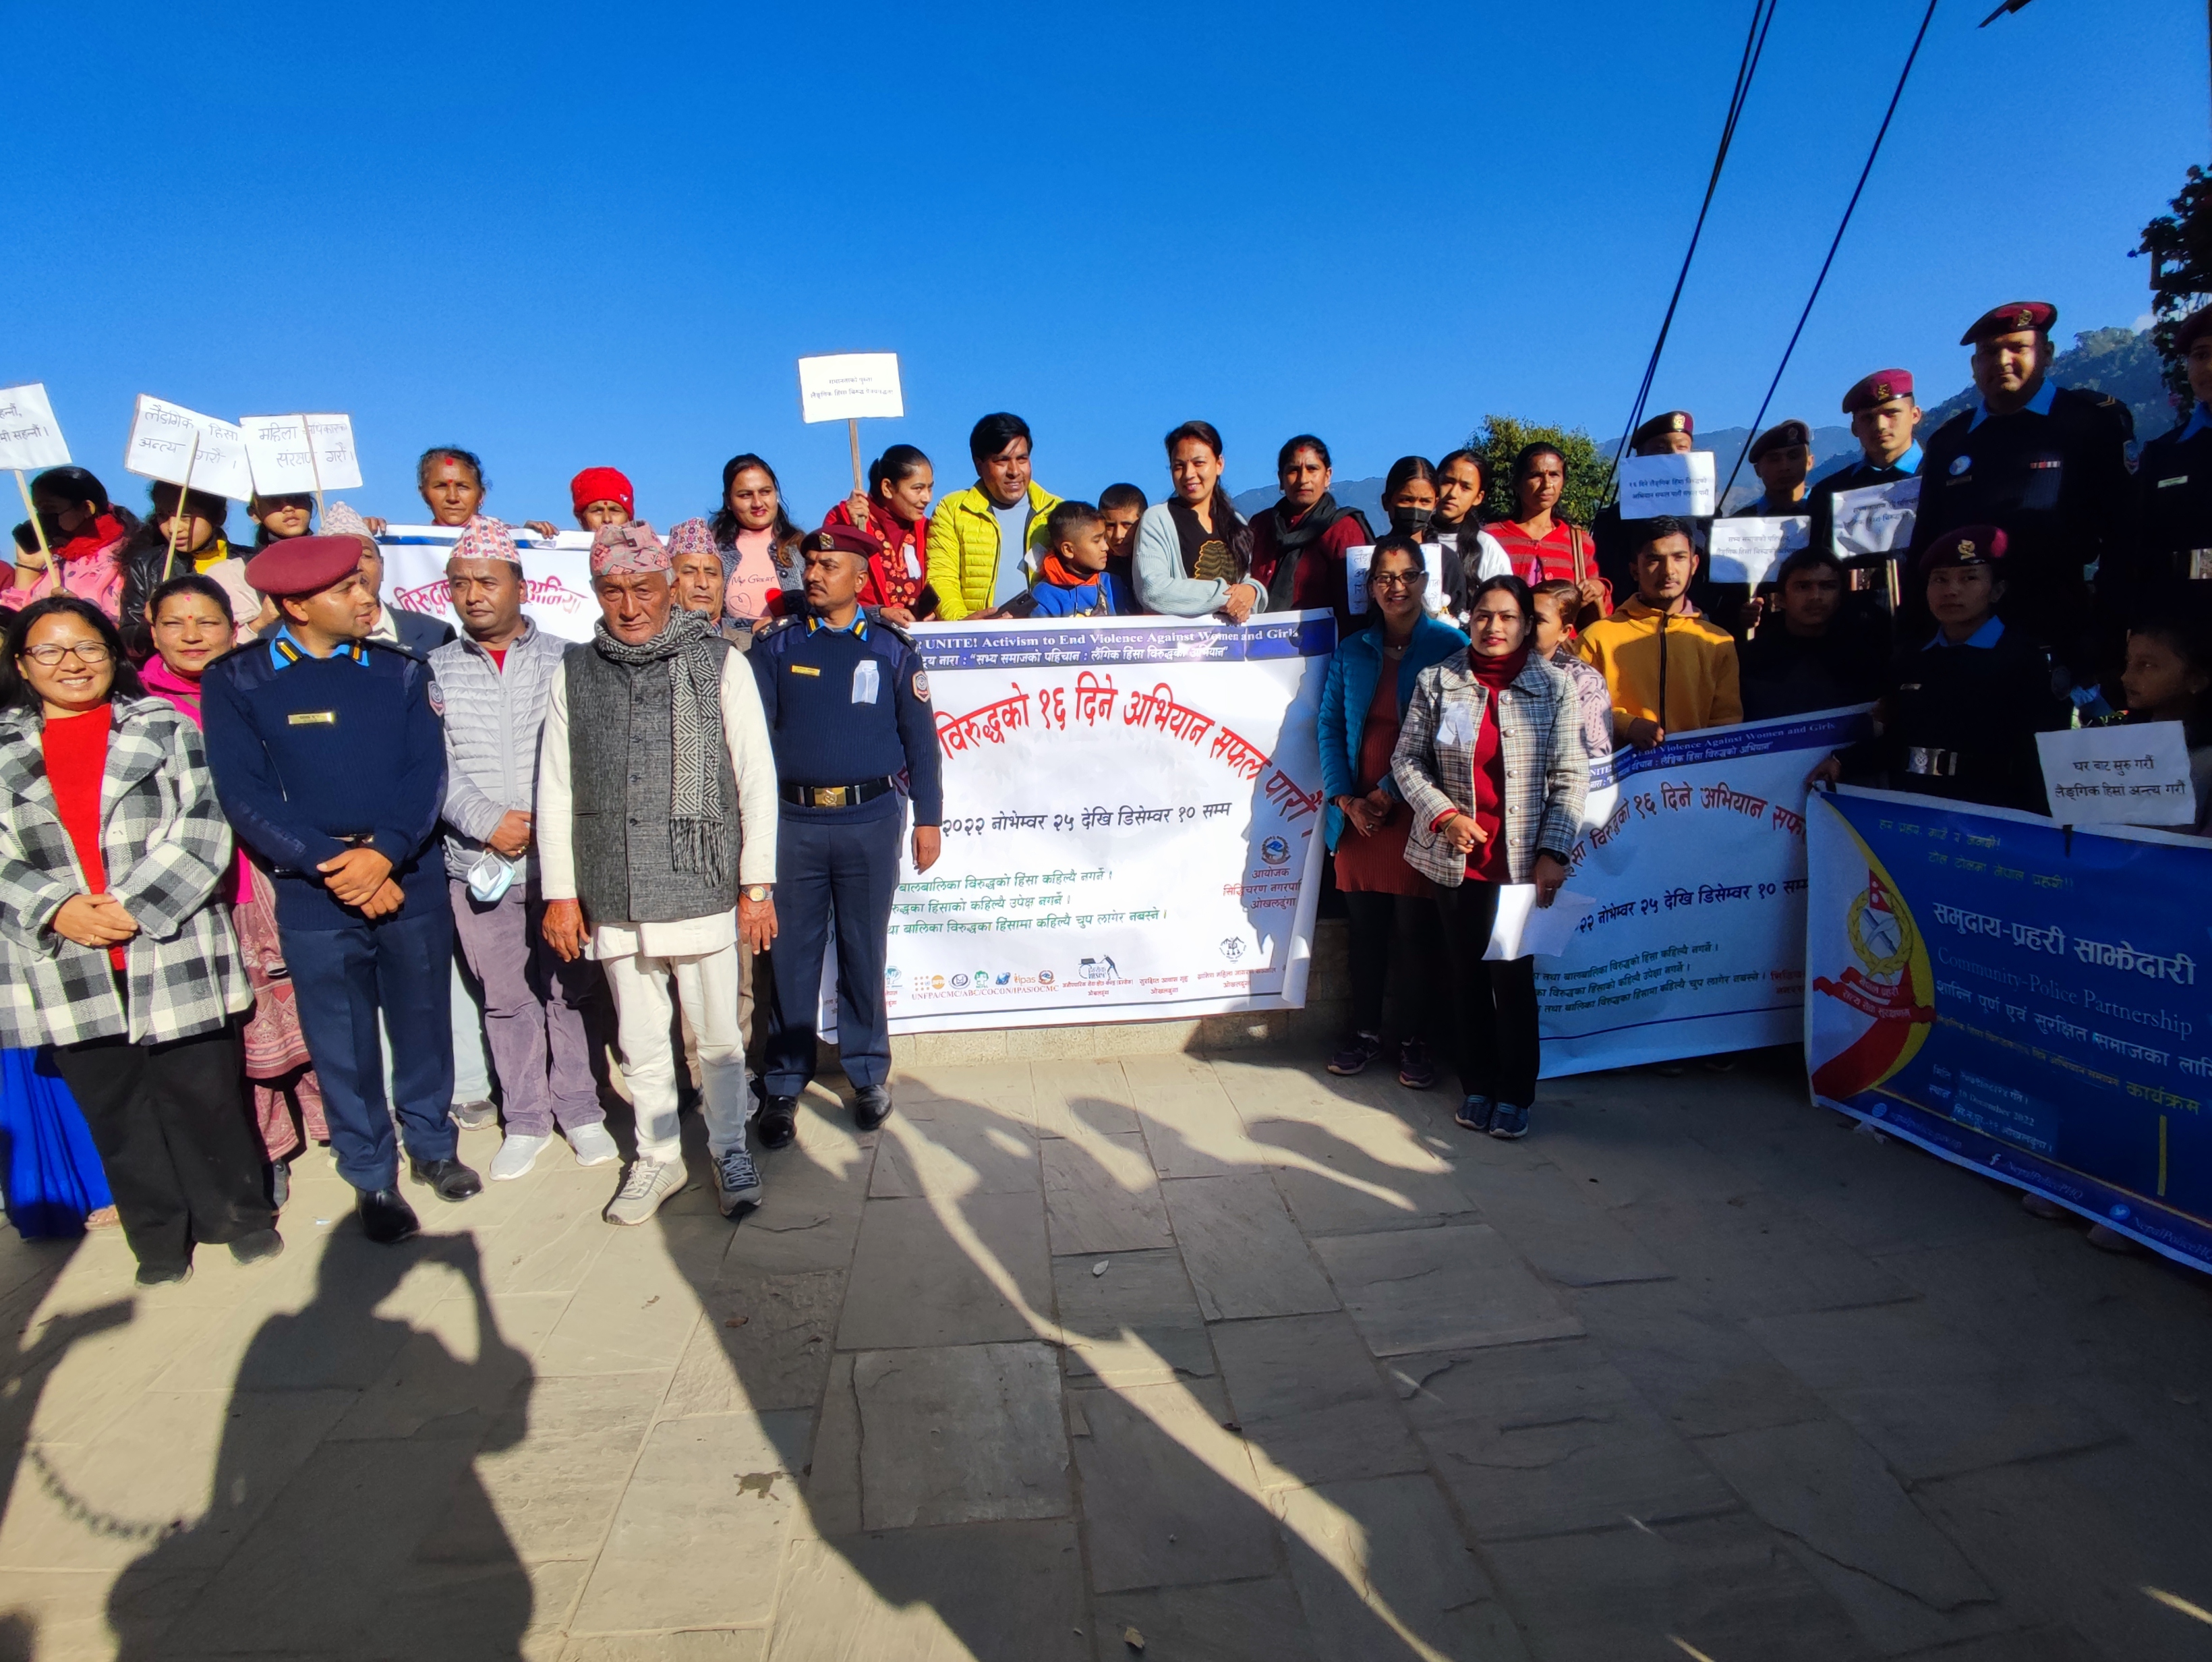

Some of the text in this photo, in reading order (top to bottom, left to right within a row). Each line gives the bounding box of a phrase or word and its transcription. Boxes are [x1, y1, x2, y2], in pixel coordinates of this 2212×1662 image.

[925, 637, 978, 650] UNITE!
[982, 636, 1039, 648] Activism
[1043, 636, 1055, 646] to
[1059, 634, 1085, 645] End
[1089, 633, 1143, 643] Violence
[1148, 631, 1195, 644] Against
[1198, 631, 1239, 642] Women
[1241, 630, 1263, 641] and
[1267, 628, 1299, 639] Girls
[1001, 649, 1041, 664] समाजको
[1044, 650, 1081, 663] पहिचान
[933, 682, 1030, 760] विरुद्धको
[1039, 687, 1066, 731] १६
[1075, 670, 1118, 726] दिने
[1124, 683, 1215, 747] अभियान
[1209, 726, 1273, 780] सफल
[1590, 764, 1612, 776] NITE
[1659, 741, 1701, 753] Violence
[1706, 736, 1743, 749] Against
[1745, 730, 1784, 741] Women
[1787, 726, 1807, 735] and
[1809, 721, 1836, 732] Girls
[2072, 761, 2090, 772] घर
[1053, 813, 1074, 831] २५
[1081, 806, 1113, 830] देखि
[1179, 806, 1196, 823] १०
[1203, 802, 1233, 819] सम्म
[1634, 793, 1657, 820] १६
[1660, 781, 1693, 812] दिने
[1700, 781, 1768, 820] अभियान
[1772, 805, 1807, 836] सफ
[1252, 866, 1291, 879] आयोजक
[892, 903, 925, 916] रुद्धका
[1640, 898, 1659, 915] २५
[1664, 887, 1694, 911] देखि
[1757, 883, 1776, 899] १०
[1932, 901, 2197, 985] समुदाय-प्रहरी साझेदारी
[1938, 946, 2193, 1042] Community-Police Partnership
